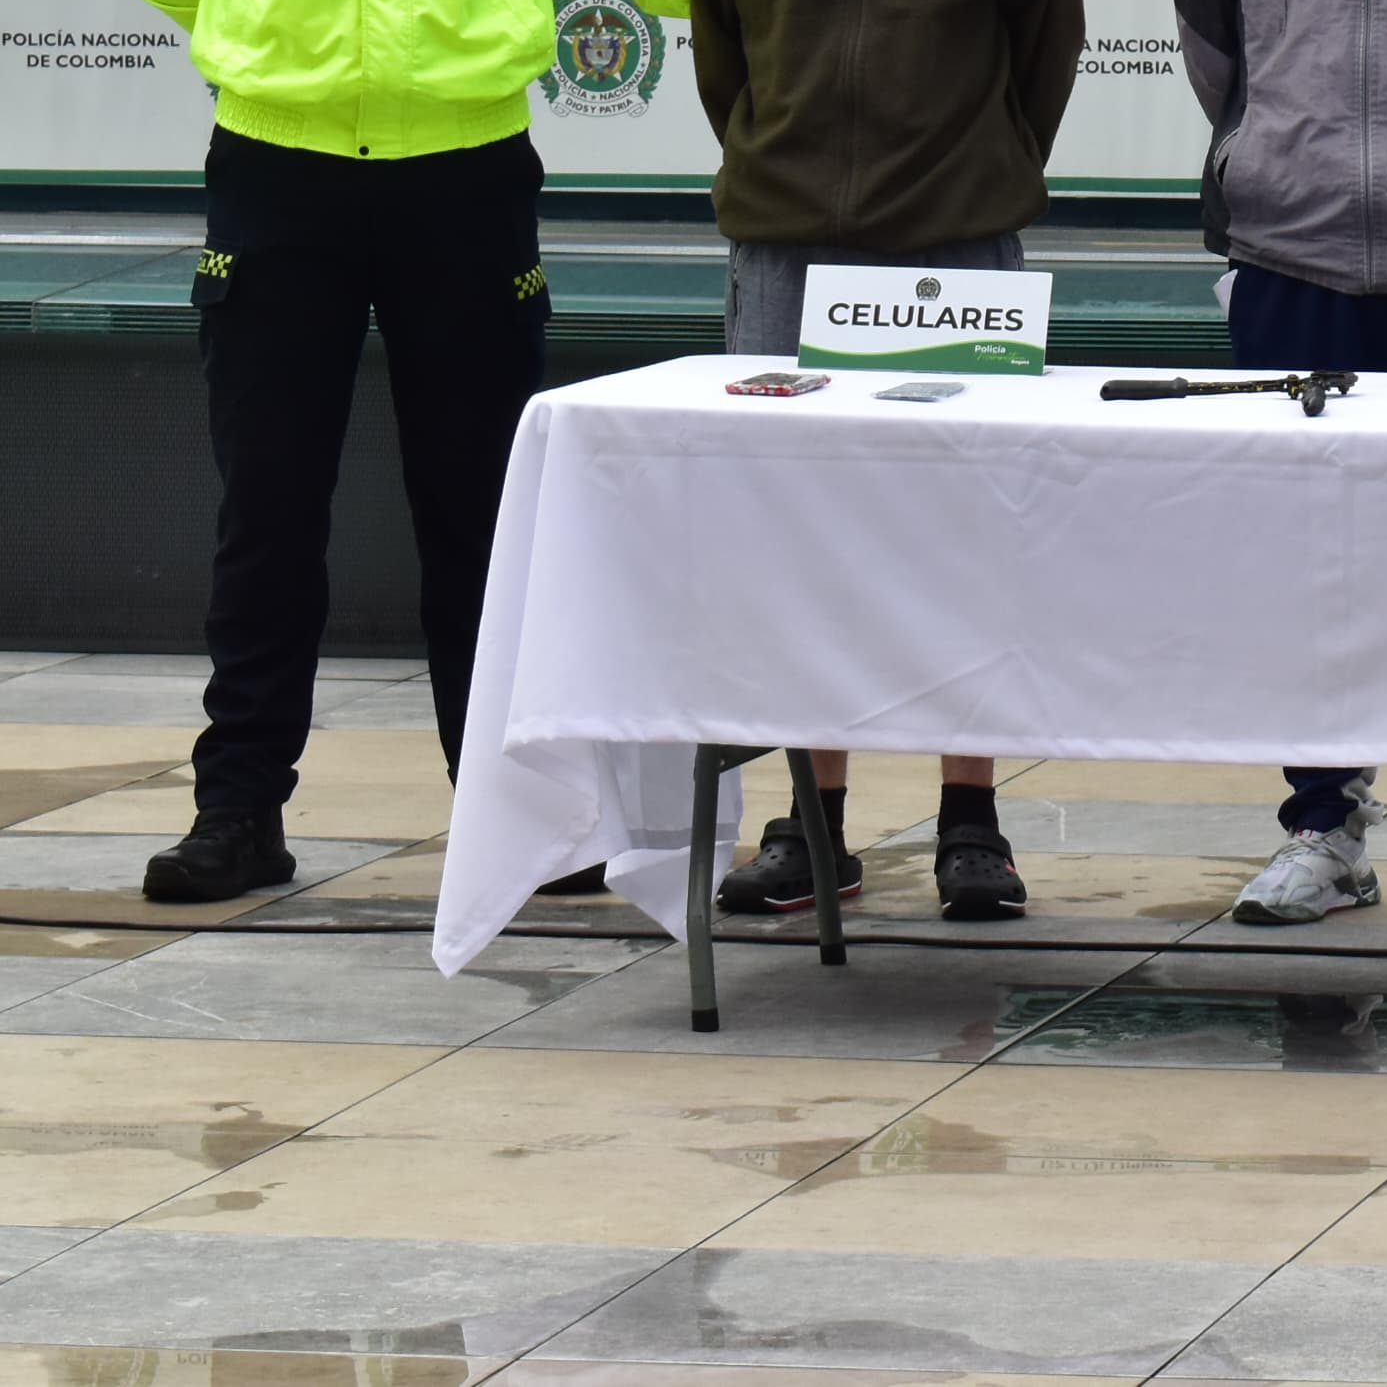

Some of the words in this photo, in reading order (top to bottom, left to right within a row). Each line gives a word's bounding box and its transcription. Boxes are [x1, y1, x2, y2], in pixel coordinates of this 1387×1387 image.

[2, 28, 75, 46] POLICÍA
[82, 34, 179, 47] NACIONAL
[27, 54, 49, 67] DE
[56, 55, 155, 68] COLOMBIA
[827, 302, 1024, 332] CELULARES
